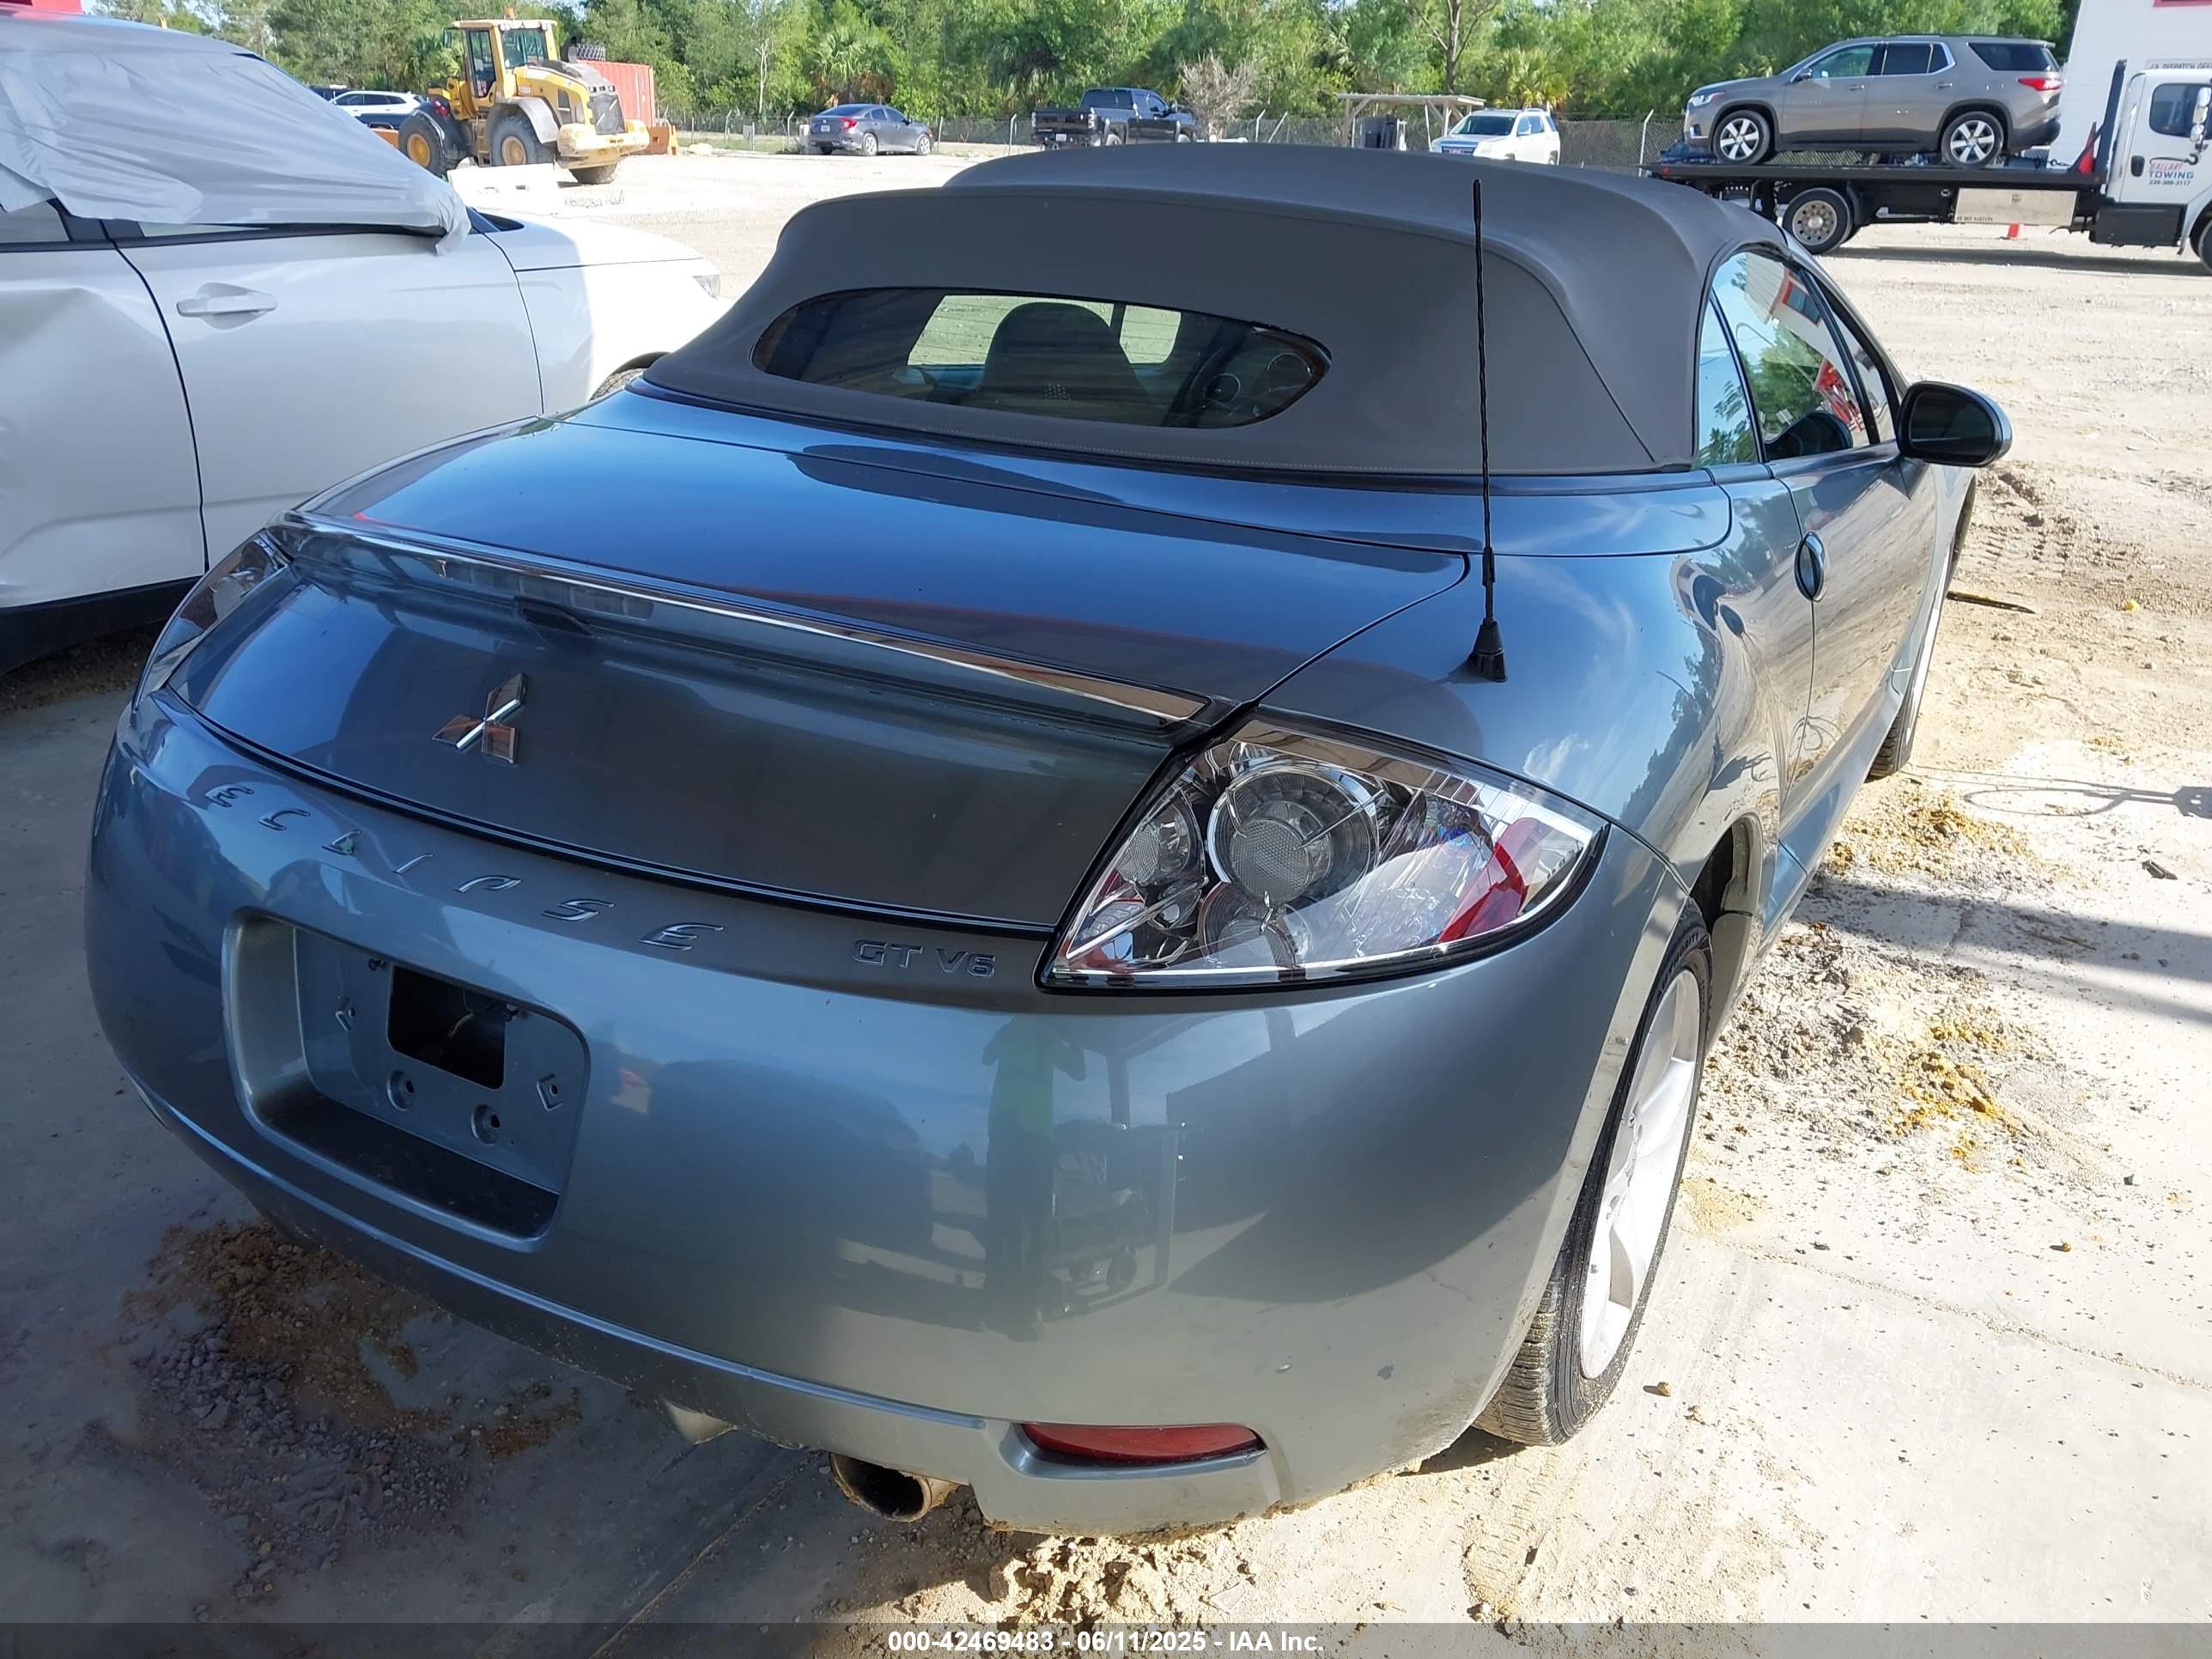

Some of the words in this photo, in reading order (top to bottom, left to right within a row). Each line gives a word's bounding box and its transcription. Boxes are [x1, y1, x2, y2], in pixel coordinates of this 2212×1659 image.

[205, 782, 725, 950] ECLIPSE
[852, 939, 924, 969] GT
[936, 947, 996, 978] V6
